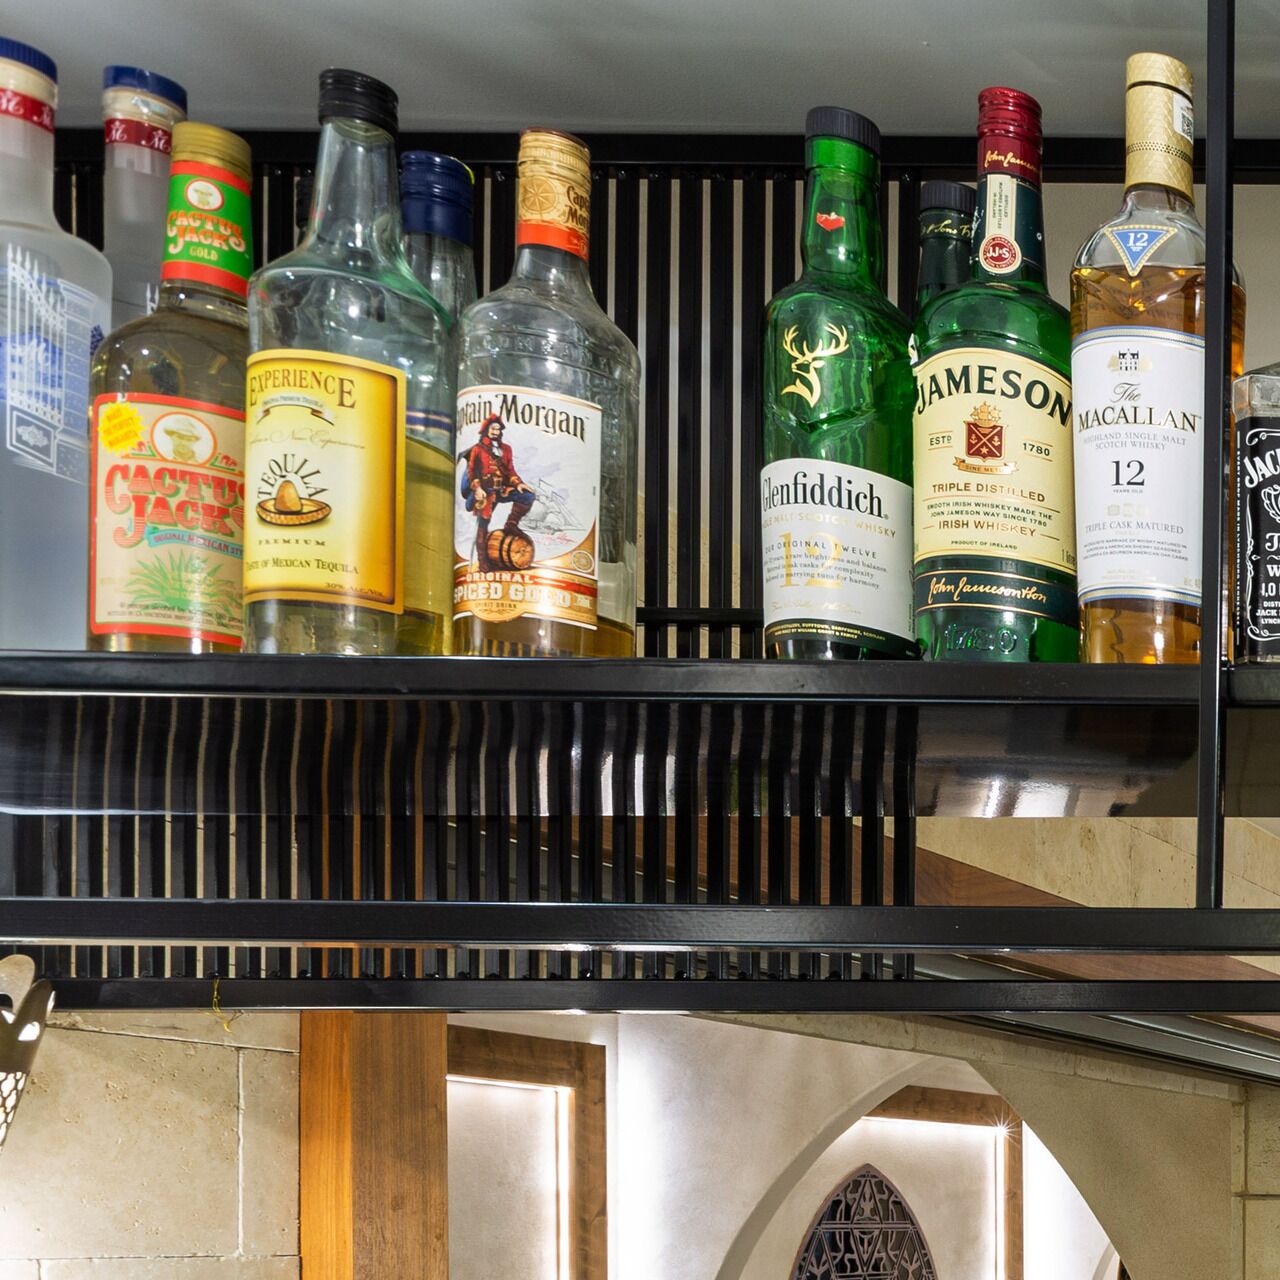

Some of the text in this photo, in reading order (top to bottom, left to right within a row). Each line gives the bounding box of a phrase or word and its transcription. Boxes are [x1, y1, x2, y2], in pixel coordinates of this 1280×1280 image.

[1127, 233, 1150, 247] 12
[190, 246, 218, 261] GOLD
[250, 368, 357, 409] EXPERIENCE
[917, 365, 1073, 427] JAMESON
[1110, 382, 1142, 403] The
[498, 393, 586, 443] Morgan
[1078, 405, 1198, 433] MACALLAN
[1095, 440, 1167, 451] SCOTCH WHISKY
[1124, 431, 1187, 446] SINGLE MALT
[1022, 442, 1051, 456] 1780
[257, 453, 330, 500] TEQUILA
[1111, 459, 1145, 487] 12
[762, 470, 884, 519] Glenfiddich
[932, 482, 1045, 503] TRIPLE DISTILLED
[974, 501, 1012, 511] WHISKEY
[1013, 507, 1036, 516] MADE
[1038, 511, 1053, 520] THE
[983, 511, 1001, 519] WAY
[1002, 512, 1028, 522] SINCE
[855, 520, 897, 539] WHISKY
[939, 519, 1036, 537] IRISH WHISKEY
[1109, 520, 1184, 535] CASK MATURED
[258, 538, 327, 547] PREMIUM
[777, 540, 878, 559] ORIGINAL TWELVE
[272, 557, 360, 576] MEXICAN TEQUILA
[778, 529, 844, 589] 12
[466, 571, 534, 583] ORIGINAL
[453, 583, 571, 608] SPICED GOLD
[928, 577, 955, 604] John
[1255, 609, 1278, 617] JACK
